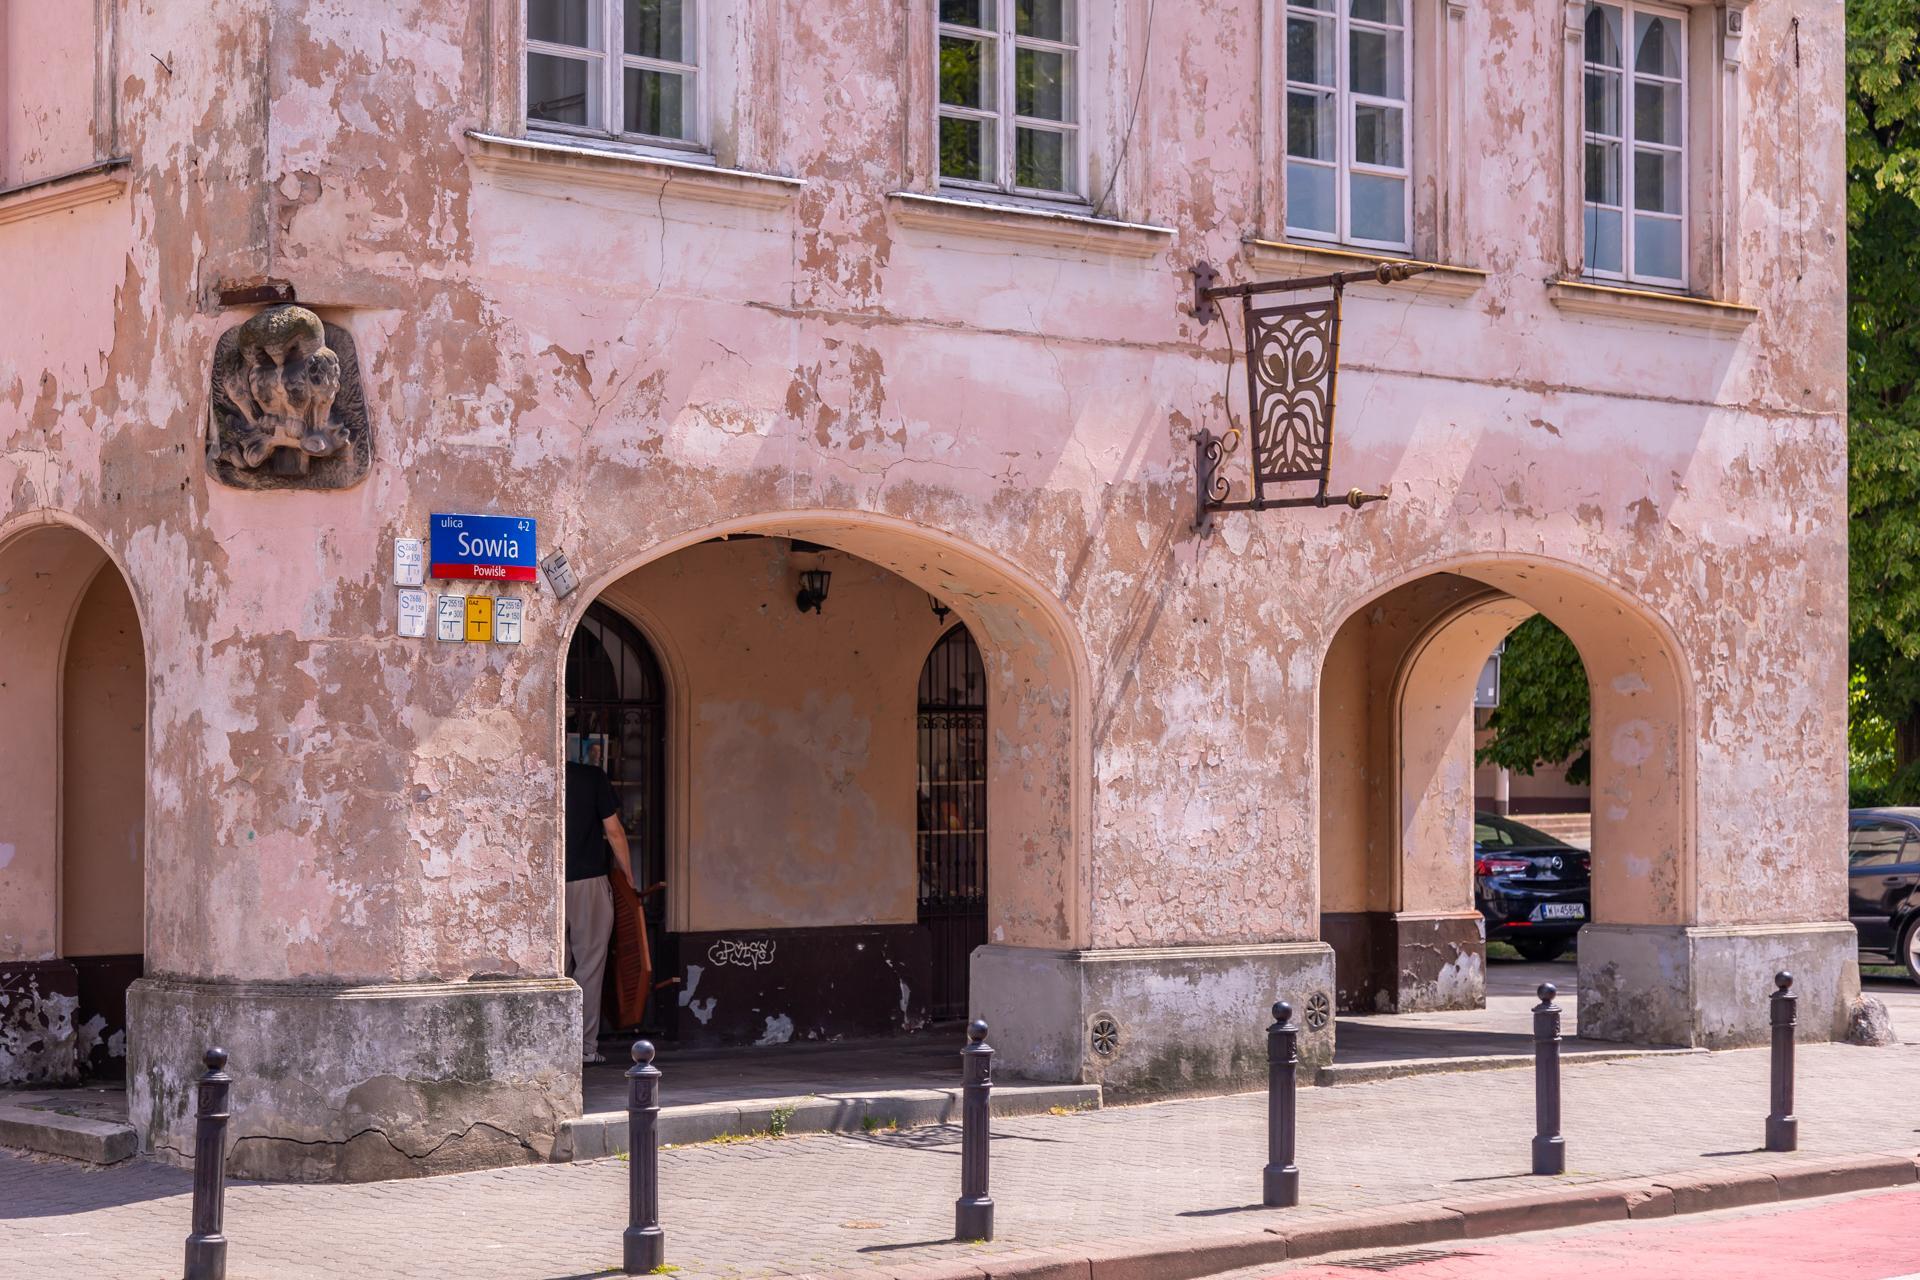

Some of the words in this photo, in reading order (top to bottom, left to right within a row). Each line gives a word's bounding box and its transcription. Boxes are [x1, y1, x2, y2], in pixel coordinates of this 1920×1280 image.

[441, 516, 463, 528] ulica
[518, 520, 530, 532] 4-2
[397, 545, 406, 558] S
[458, 532, 519, 559] Sowia
[411, 553, 421, 562] 150
[473, 565, 507, 577] Powiśle
[401, 595, 410, 609] S
[415, 604, 425, 613] 150
[440, 601, 448, 615] Z
[453, 610, 464, 618] 300
[497, 603, 506, 617] Z
